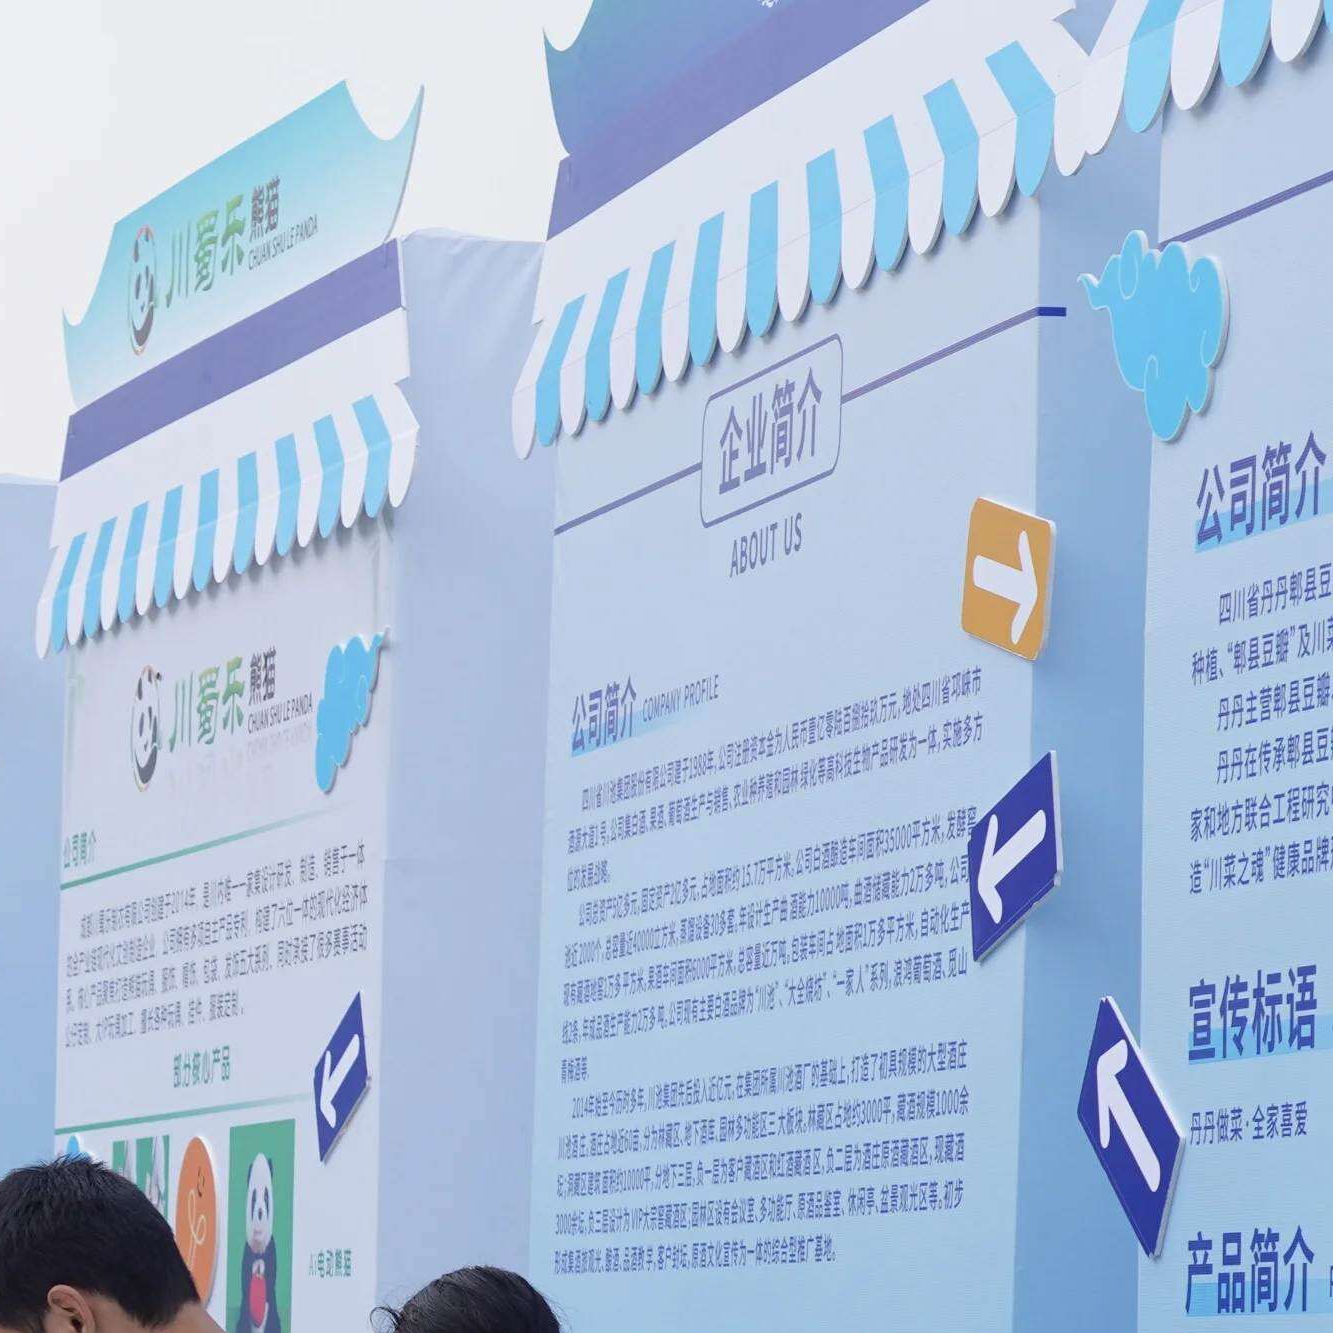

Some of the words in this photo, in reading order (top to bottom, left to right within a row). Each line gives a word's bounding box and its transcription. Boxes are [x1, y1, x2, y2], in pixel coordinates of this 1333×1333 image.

[165, 194, 245, 308] 川蜀乐
[249, 176, 281, 242] 熊猫
[248, 245, 271, 271] CHUAN
[271, 238, 285, 259] SHU
[286, 236, 294, 252] LE
[295, 213, 318, 247] PANDA
[718, 367, 822, 495] 企业简介
[1196, 430, 1326, 546] 公司简介
[729, 523, 777, 578] ABOUT
[784, 512, 803, 555] US
[170, 656, 245, 754] 川蜀乐
[249, 647, 277, 707] 熊猫
[247, 710, 268, 735] CHUAN
[269, 705, 282, 728] SHU
[283, 702, 292, 723] LE
[292, 691, 314, 721] PANDA
[571, 675, 637, 752] 公司简介
[641, 686, 682, 724] COMPANY
[683, 673, 720, 705] PROFILE
[1216, 668, 1333, 733] 丹丹主营郫县豆瓣
[1216, 721, 1333, 785] 丹丹在传承郫县豆
[1190, 781, 1333, 842] 家和地方联合工程研究
[1188, 964, 1318, 1061] 宣传标语
[173, 1045, 230, 1089] 部分核心产品
[1185, 1225, 1315, 1314] 产品简介
